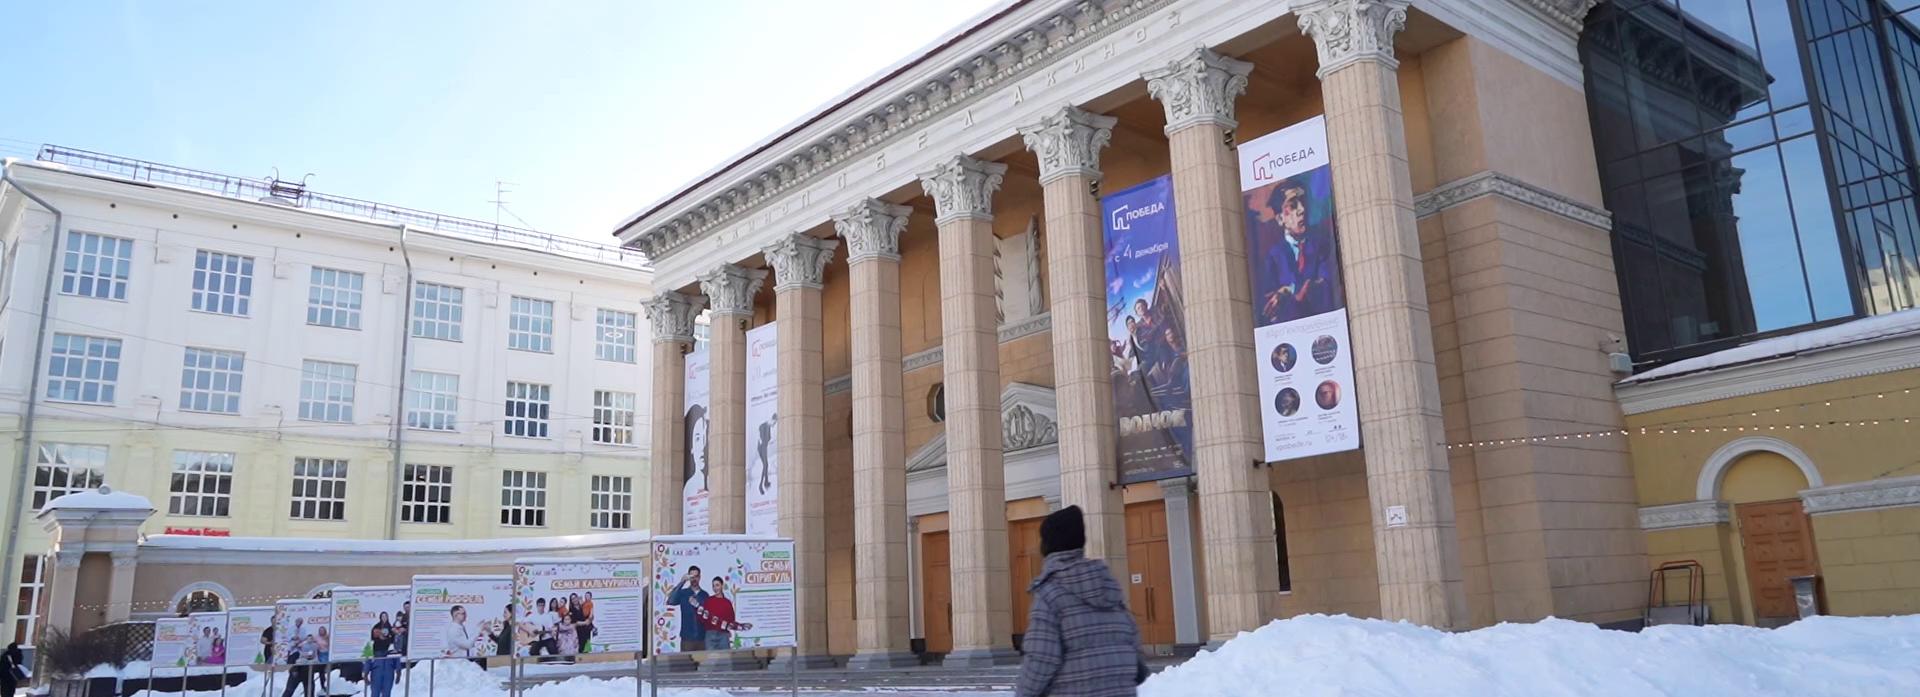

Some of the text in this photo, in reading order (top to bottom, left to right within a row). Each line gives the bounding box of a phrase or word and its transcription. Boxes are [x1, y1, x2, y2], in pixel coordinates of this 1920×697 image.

[801, 85, 1025, 211] ПОБЕДА
[1269, 146, 1316, 169] ПОБЕДА
[1126, 201, 1165, 221] ПОБЕДА
[1135, 242, 1169, 259] декабря
[762, 559, 792, 572] СЕМЬИ
